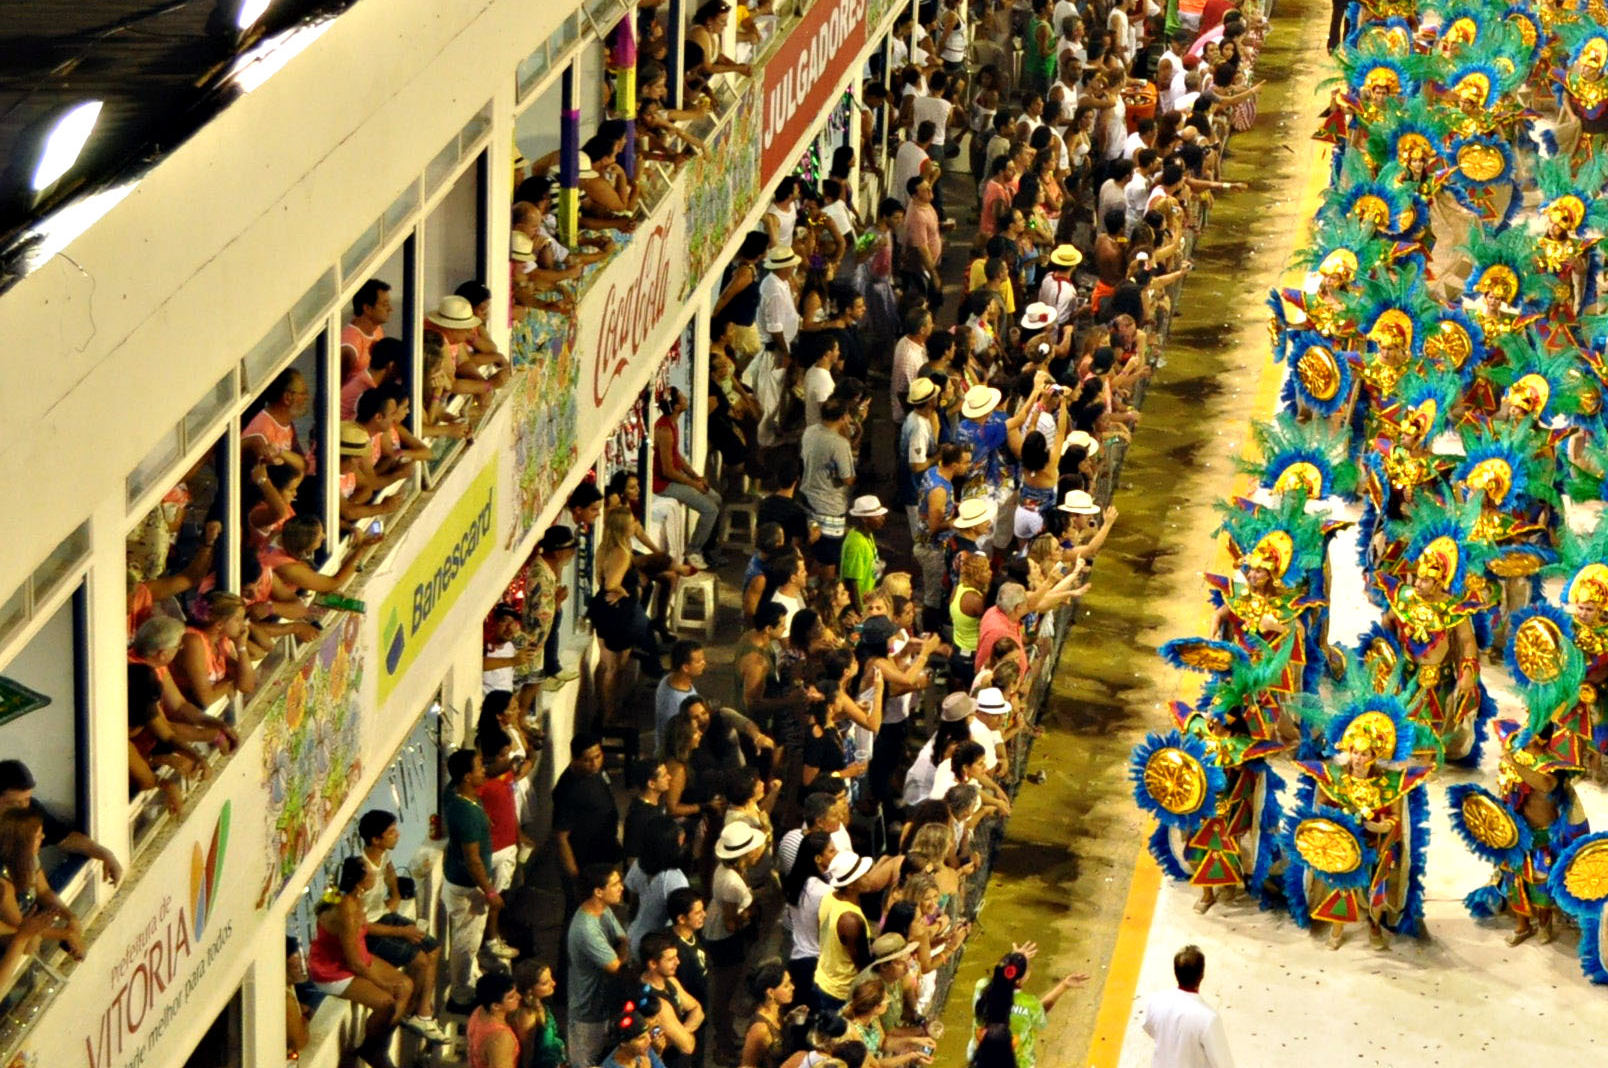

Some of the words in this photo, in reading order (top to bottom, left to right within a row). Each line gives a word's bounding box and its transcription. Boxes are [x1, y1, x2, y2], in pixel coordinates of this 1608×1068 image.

[594, 209, 675, 408] Coca-Cola
[411, 486, 493, 638] Banescard
[160, 895, 172, 923] de
[86, 905, 192, 1068] VITÓRIA
[148, 990, 184, 1051] melhor
[184, 959, 206, 1004] para
[207, 918, 233, 966] todos
[1010, 1005, 1030, 1016] NIA
